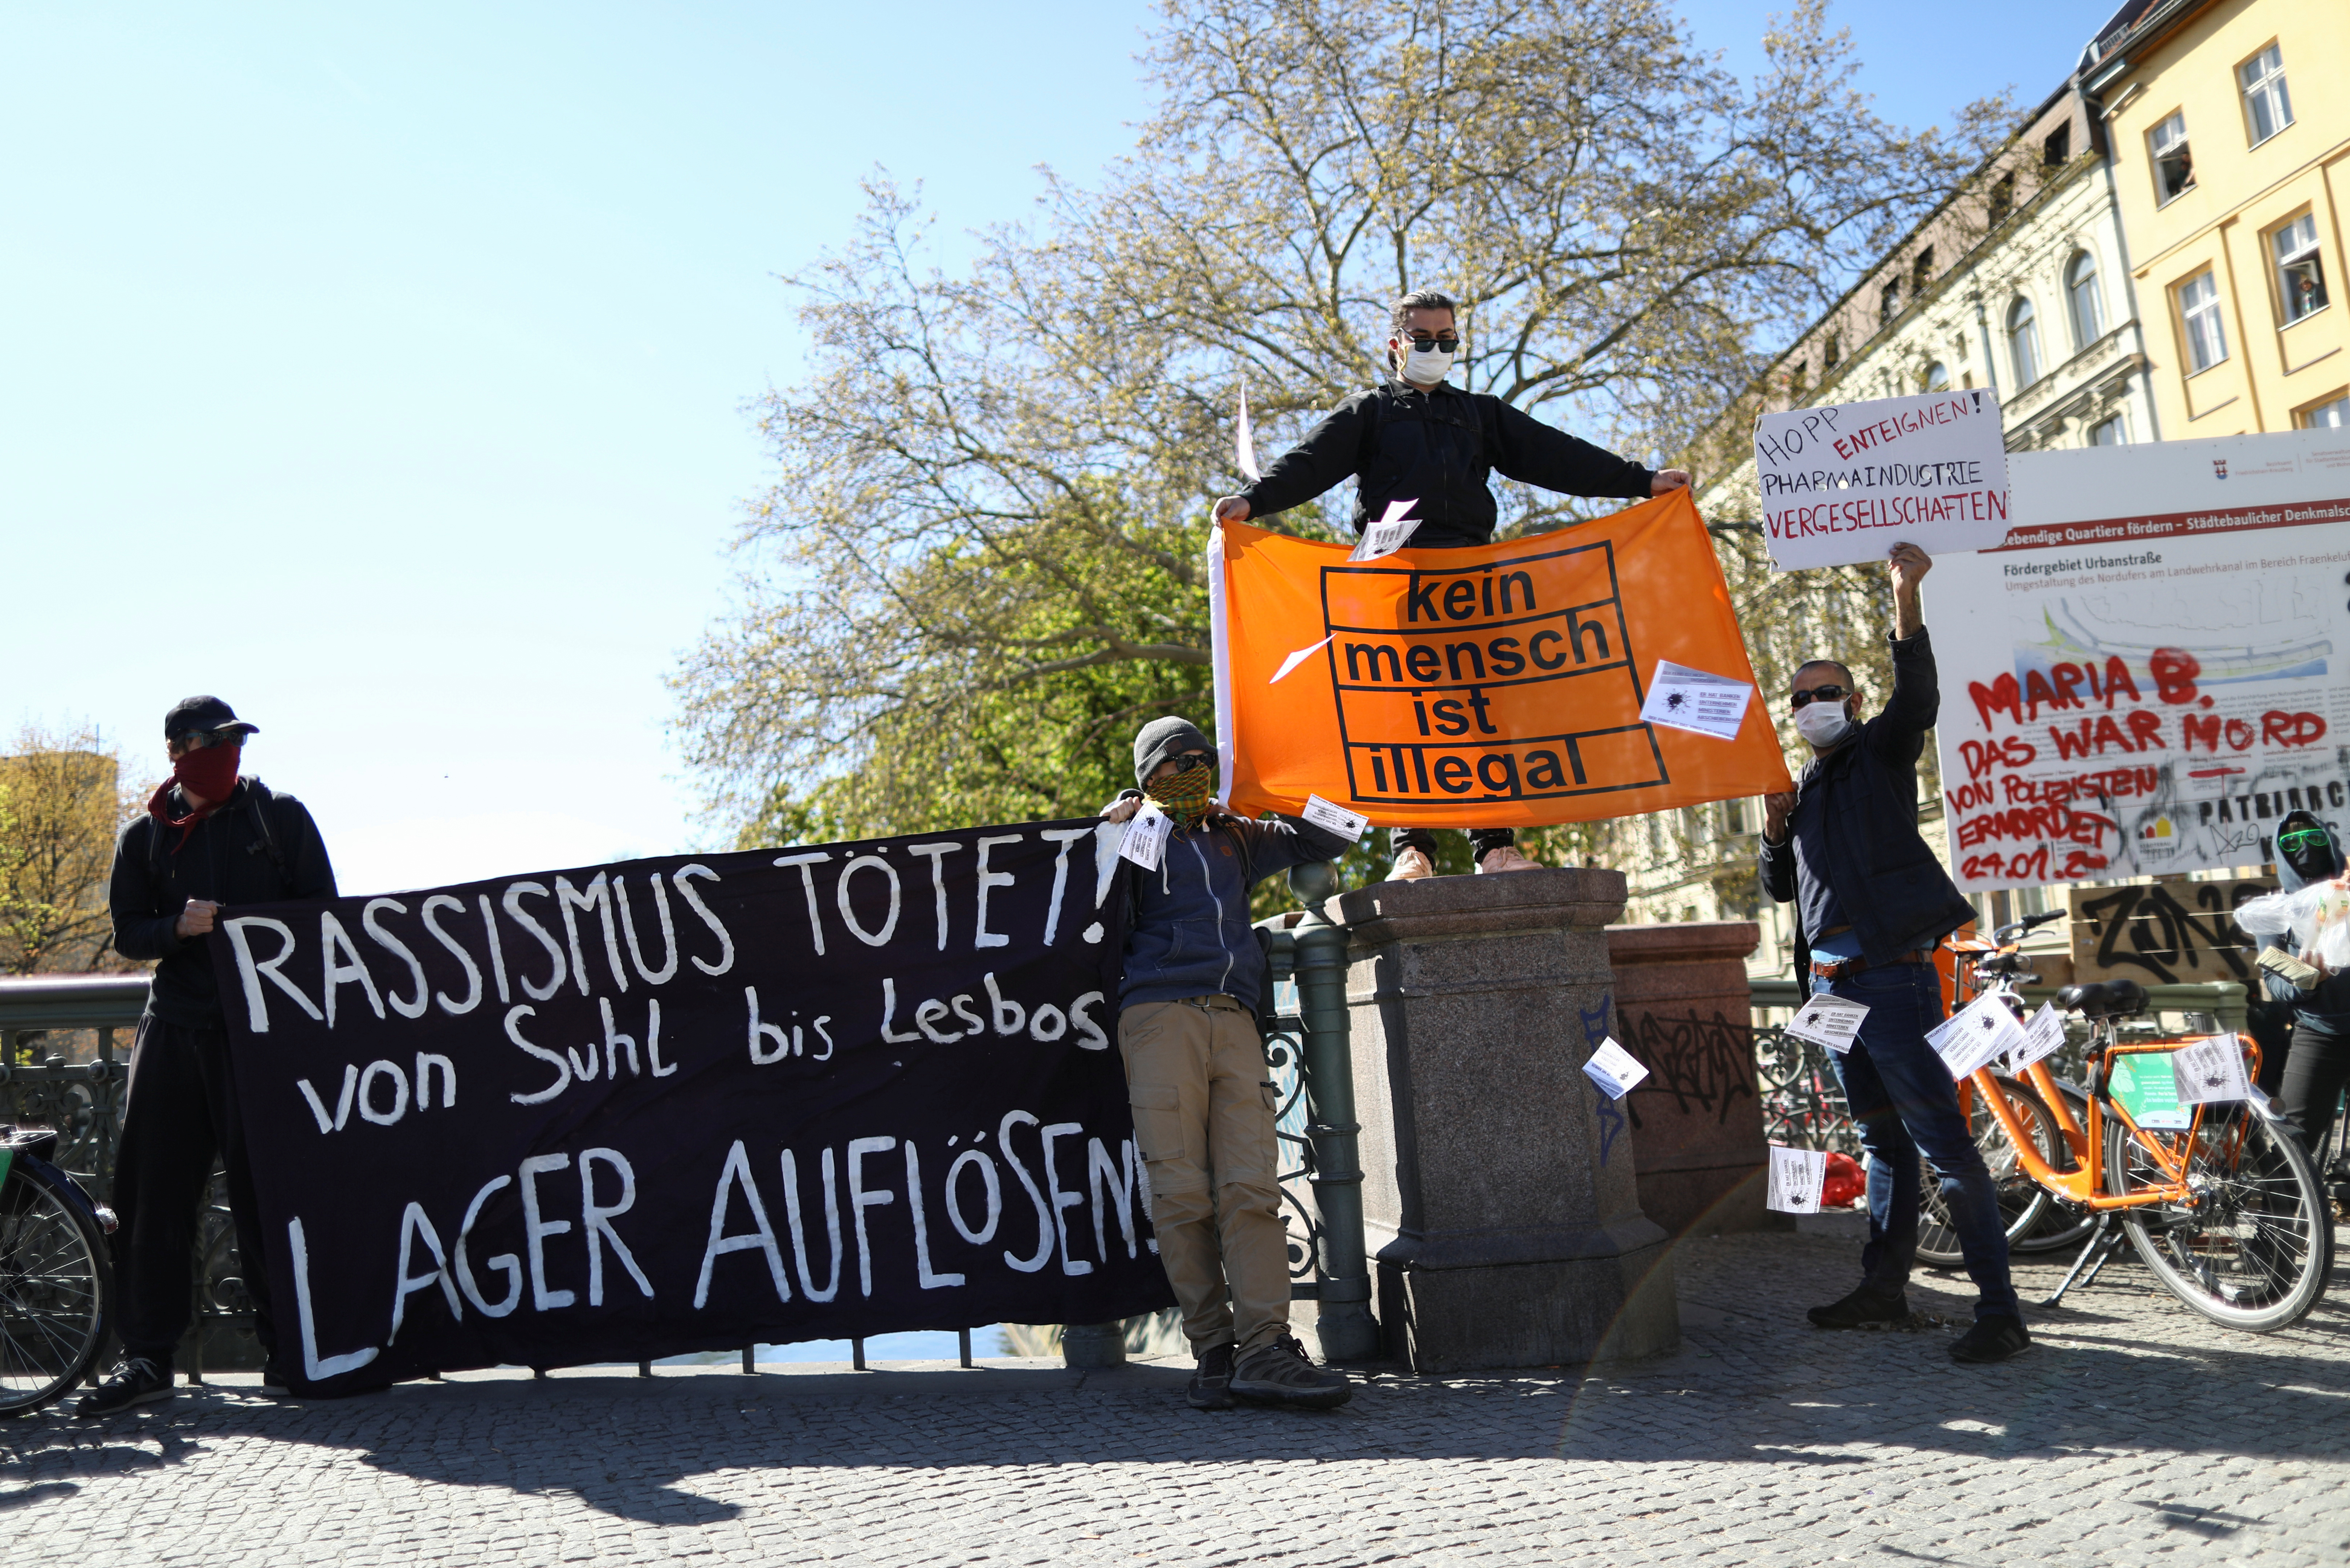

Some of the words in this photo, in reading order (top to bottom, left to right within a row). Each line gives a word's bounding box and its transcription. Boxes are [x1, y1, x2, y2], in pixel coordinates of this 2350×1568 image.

[1759, 408, 1838, 466] HOPP
[1767, 490, 2007, 539] VERGESELLSCHAFTEN
[2007, 529, 2063, 545] ebendige
[2065, 526, 2124, 542] Quartiere
[2127, 520, 2173, 535] fördern
[2187, 511, 2282, 530] Städtebaulicher
[2285, 504, 2350, 521] Denkmalsc
[2004, 558, 2082, 576] Fördergebiet
[2085, 551, 2162, 568] Urbanstraße
[2006, 576, 2076, 593] Umgestaltung
[2078, 573, 2094, 585] des
[2097, 570, 2146, 583] Nordufers
[2150, 569, 2165, 578] am
[2168, 561, 2243, 577] Landwehrkanal
[2246, 560, 2258, 569] im
[2261, 556, 2296, 569] Bereich
[1408, 569, 1537, 623] kein
[1344, 610, 1612, 682] mensch
[1414, 689, 1498, 736] ist
[1969, 655, 2141, 732] MARIA
[2150, 647, 2215, 708] B.
[1959, 736, 2035, 780] DAS
[2050, 710, 2166, 761] WAR
[2183, 711, 2327, 752] MORD
[1370, 740, 1587, 799] illegal
[1946, 779, 1994, 816] VON
[2199, 780, 2350, 827] PATRIARC
[223, 863, 734, 1033] RASSISMUS
[774, 821, 1130, 955] TÖTET!
[1948, 1016, 1959, 1025] VIRUS
[1972, 999, 1982, 1008] FEIND
[297, 1051, 457, 1134] von
[505, 997, 678, 1107] Suhl
[747, 986, 833, 1065] bis
[882, 972, 1111, 1052] Lesbos
[1949, 1032, 1970, 1053] MINISTERIEN
[1952, 1036, 1976, 1061] UNTERNEHMEN
[1956, 1053, 1970, 1067] BANKEN
[1992, 1047, 2000, 1056] NICHT
[289, 1148, 654, 1382] LAGER
